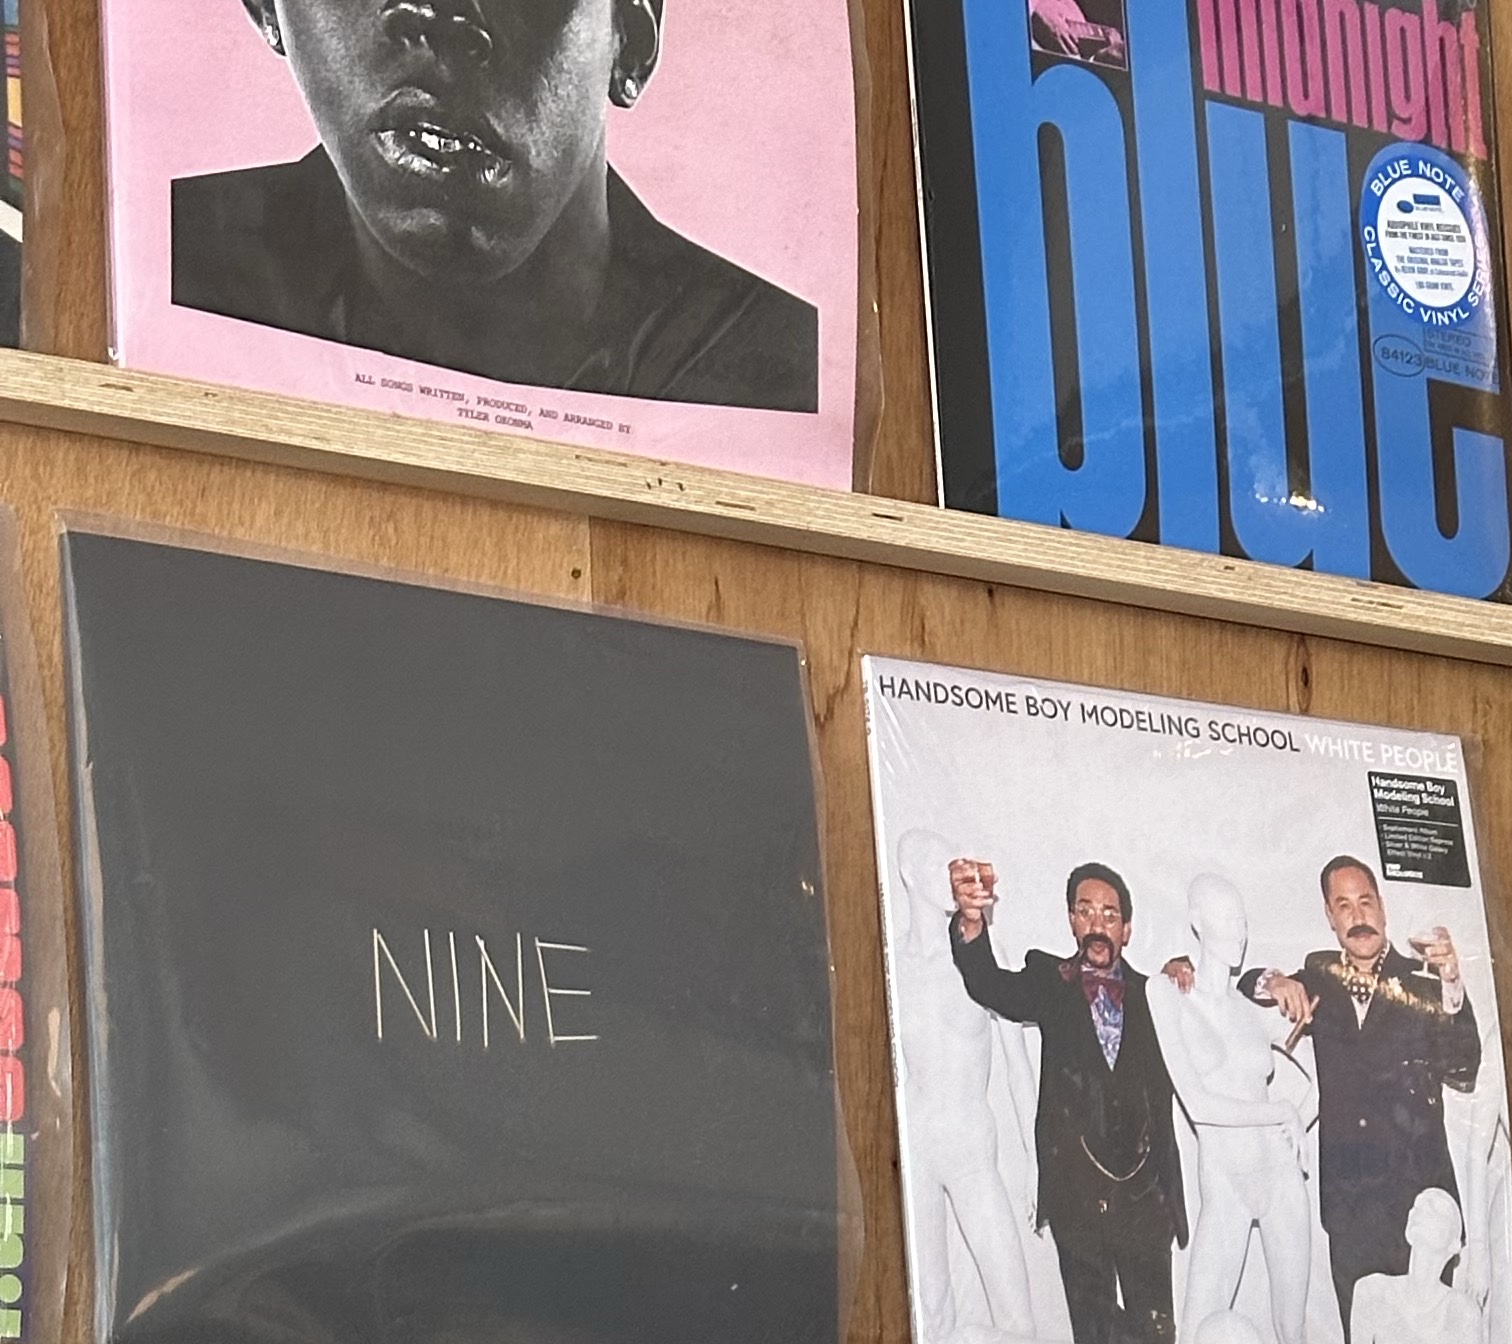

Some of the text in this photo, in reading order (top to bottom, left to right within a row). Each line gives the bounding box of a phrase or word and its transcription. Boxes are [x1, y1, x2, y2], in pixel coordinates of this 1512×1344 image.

[1371, 159, 1465, 203] BLUE NOTE
[961, 0, 1511, 598] blue
[1363, 226, 1415, 314] CLASSIC
[1419, 306, 1470, 327] VINYL
[355, 373, 375, 386] ALL
[381, 378, 413, 392] SONGS
[539, 408, 557, 420] AND
[457, 408, 489, 423] TYLER
[878, 675, 1460, 775] HANDSOME BOY MODELING SCHOOL WHITE PEOPLE
[1371, 776, 1445, 795] Handsome Boy
[1373, 788, 1455, 807] Modeling School
[371, 927, 598, 1047] NINE
